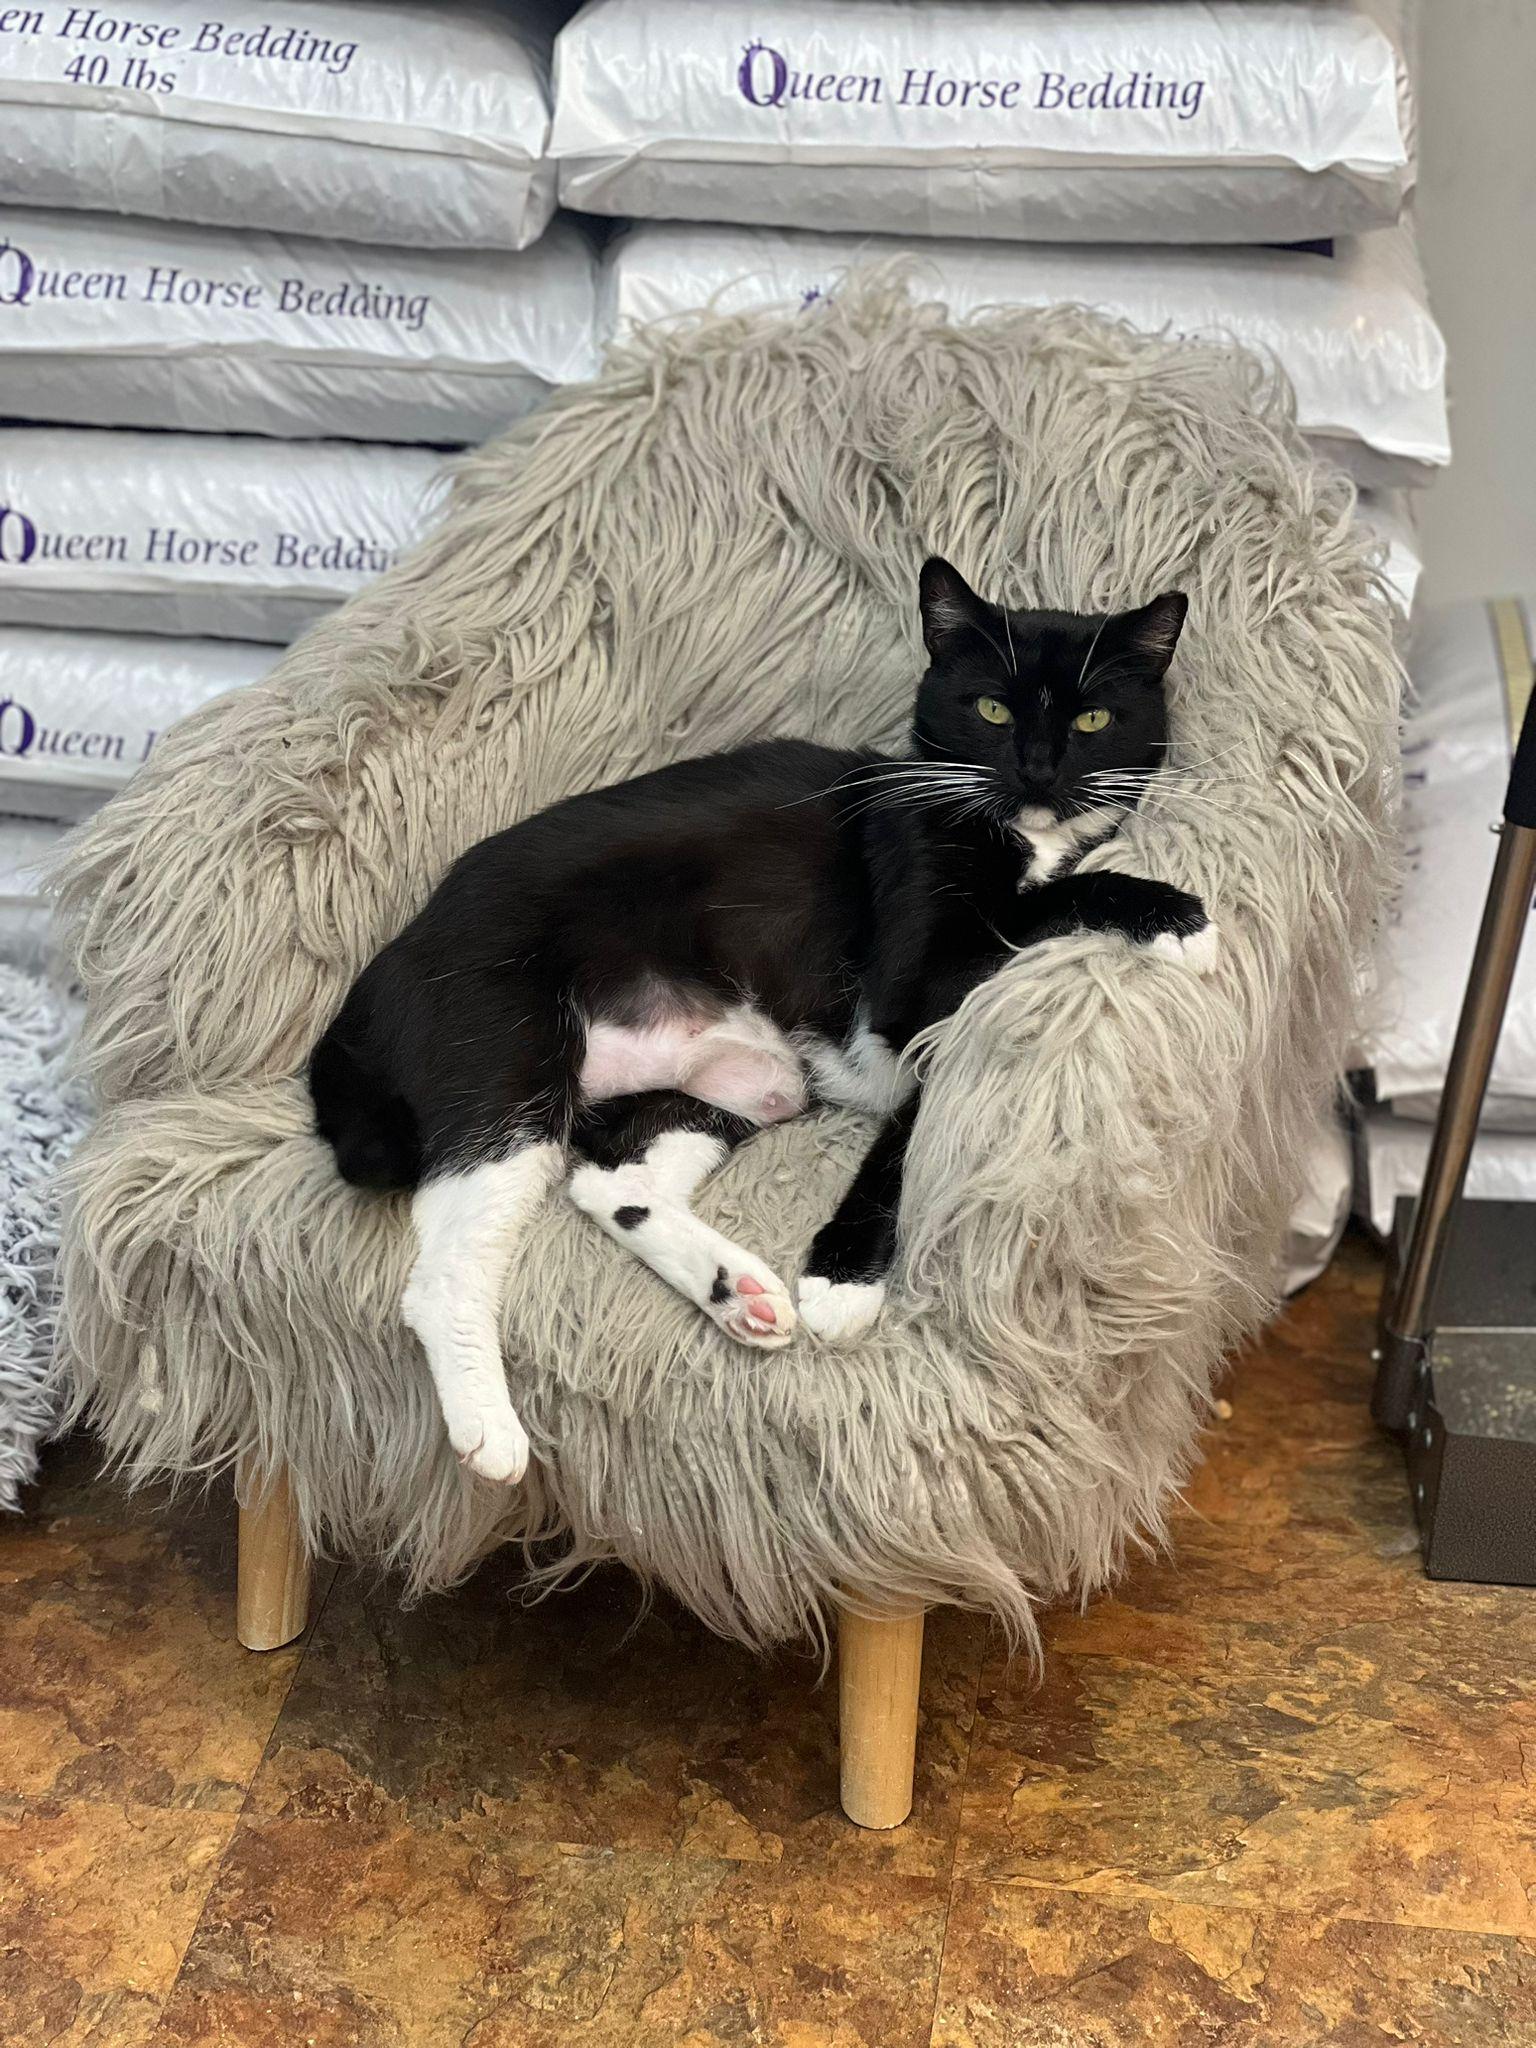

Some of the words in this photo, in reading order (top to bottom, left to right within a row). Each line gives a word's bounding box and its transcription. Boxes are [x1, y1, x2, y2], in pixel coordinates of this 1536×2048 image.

[0, 8, 45, 35] en
[56, 7, 181, 49] Horse
[190, 22, 360, 74] Bedding
[64, 53, 109, 85] 40
[121, 57, 177, 94] lbs
[737, 44, 883, 108] Queen
[896, 67, 1021, 109] Horse
[1034, 71, 1206, 120] Bedding
[0, 246, 127, 306] Queen
[141, 266, 263, 309] Horse
[277, 279, 431, 330] Bedding
[0, 509, 127, 564] Queen
[144, 528, 259, 568] Horse
[274, 533, 400, 573] Beddin
[0, 702, 125, 761] Queen
